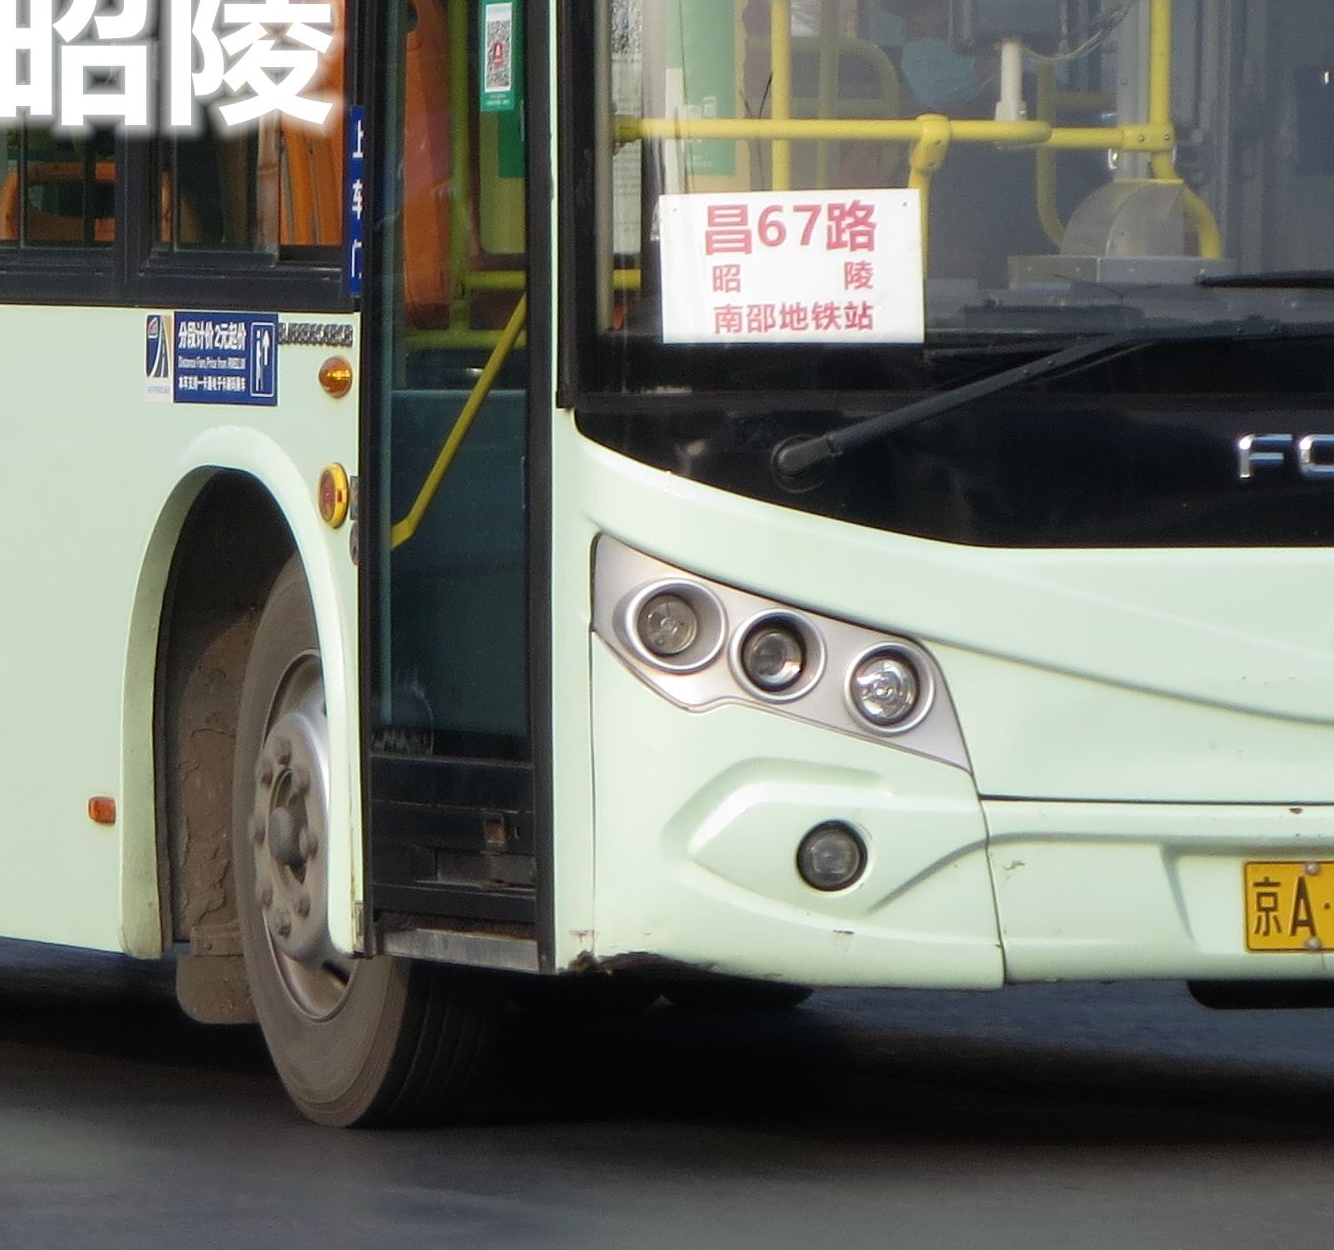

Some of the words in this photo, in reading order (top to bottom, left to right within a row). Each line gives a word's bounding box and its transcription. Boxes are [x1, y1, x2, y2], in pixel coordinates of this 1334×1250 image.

[704, 199, 877, 257] 昌67路
[713, 300, 875, 335] 南邵地铁站
